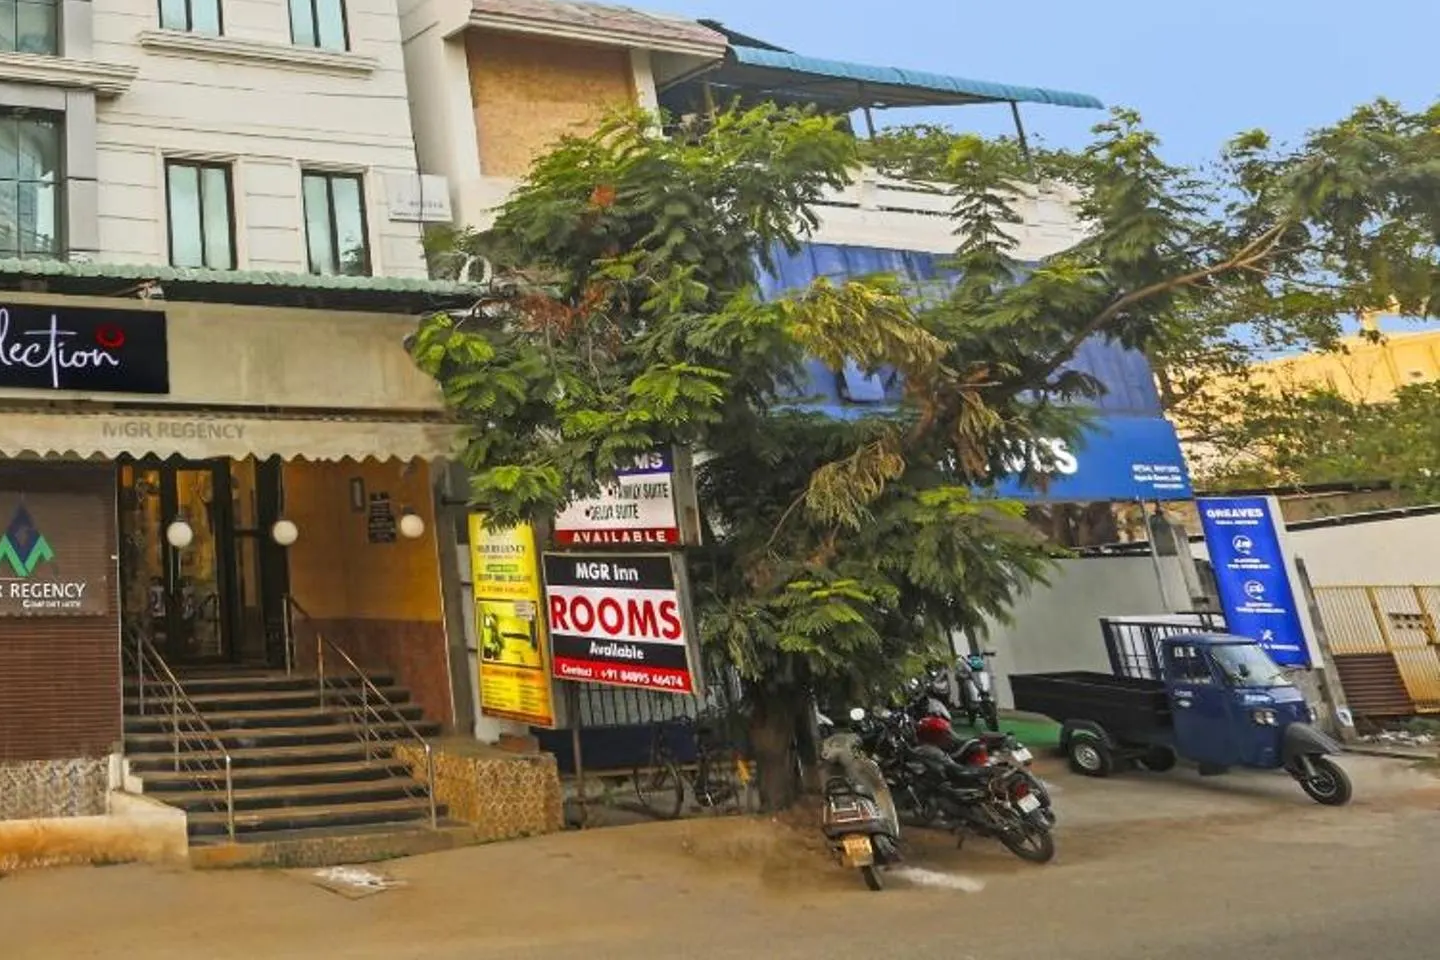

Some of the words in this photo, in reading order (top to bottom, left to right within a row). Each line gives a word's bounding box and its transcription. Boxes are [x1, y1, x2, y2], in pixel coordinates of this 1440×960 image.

[102, 421, 152, 439] MGR
[158, 421, 247, 440] REGENCY
[573, 530, 667, 543] AVAILABLE
[575, 562, 611, 581] MGR
[10, 582, 86, 598] REGENCY
[549, 595, 682, 640] ROOMS
[589, 642, 645, 660] Available
